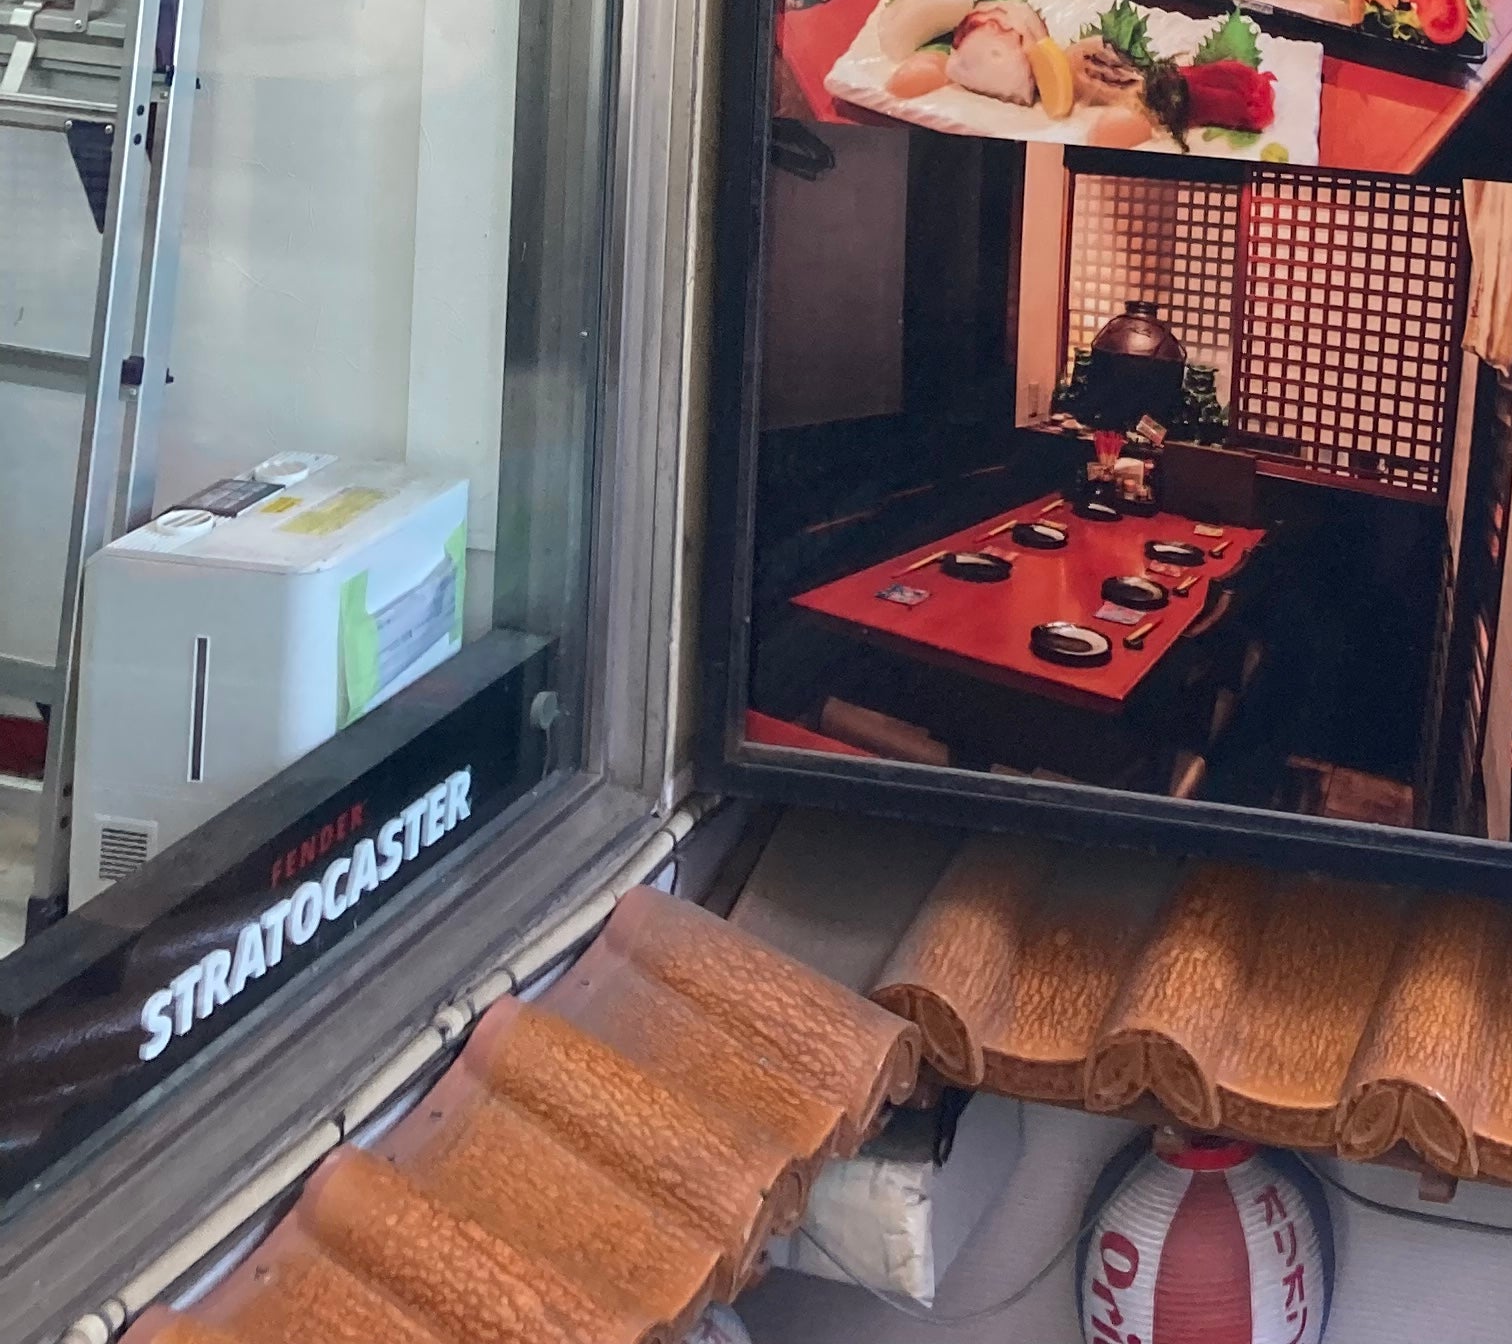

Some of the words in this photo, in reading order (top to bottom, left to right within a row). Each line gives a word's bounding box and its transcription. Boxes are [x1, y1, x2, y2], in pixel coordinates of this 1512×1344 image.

[271, 800, 367, 888] FENDER
[139, 768, 472, 1061] STRATOCASTER
[1091, 1230, 1142, 1344] Ori
